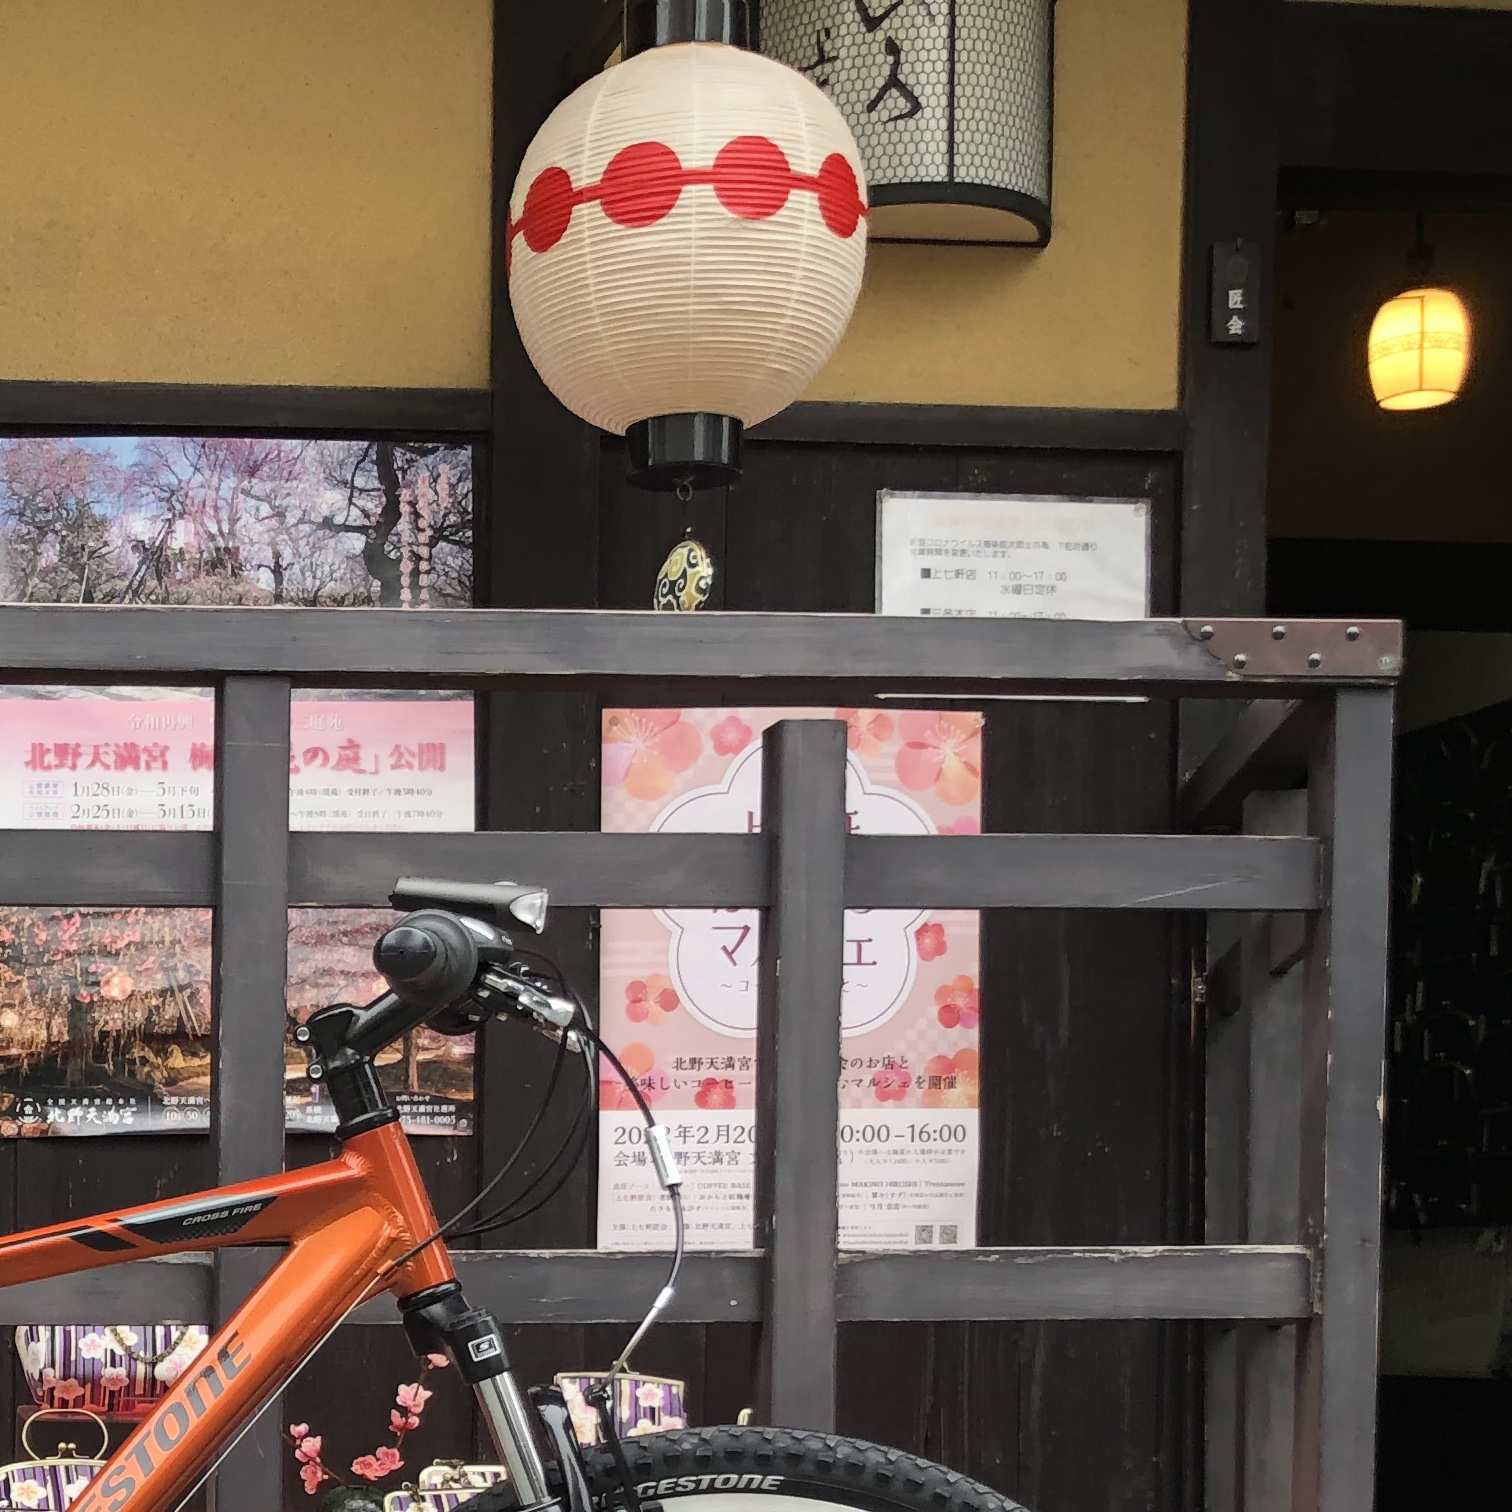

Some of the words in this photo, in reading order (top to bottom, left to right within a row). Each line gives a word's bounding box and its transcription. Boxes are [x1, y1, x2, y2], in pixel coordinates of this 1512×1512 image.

[1227, 289, 1245, 335] 匠会
[24, 742, 170, 772] 北野天満宮
[673, 1055, 759, 1072] 北野天満宮
[46, 1105, 138, 1126] 北野天満宮
[398, 1114, 456, 1125] 75-461-0005
[651, 1151, 742, 1167] 野天満宮
[182, 1210, 230, 1226] CROSS
[231, 1202, 263, 1216] FIRE
[634, 1473, 786, 1498] GESTONE
